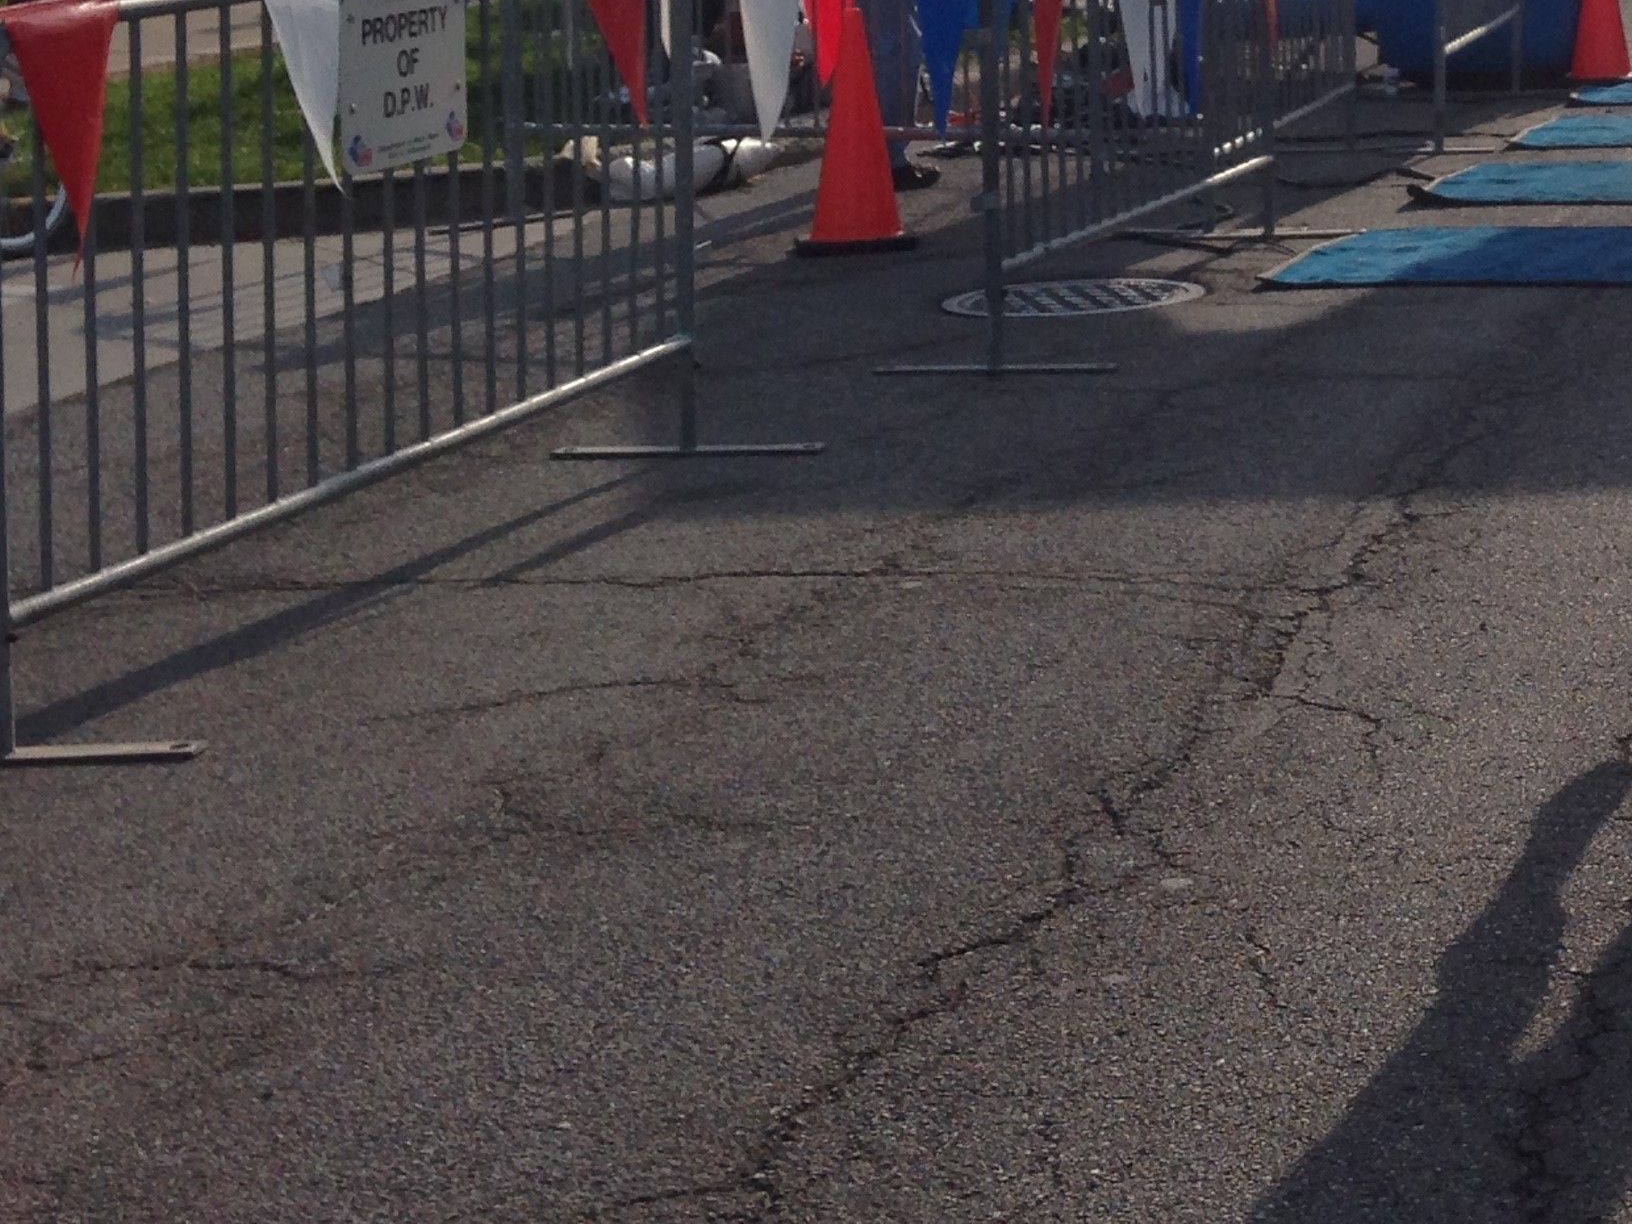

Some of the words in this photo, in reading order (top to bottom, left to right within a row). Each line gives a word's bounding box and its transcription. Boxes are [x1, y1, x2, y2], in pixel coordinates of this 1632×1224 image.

[360, 5, 449, 46] PROPERTY
[396, 47, 420, 78] OF
[382, 82, 435, 119] D.P.W.
